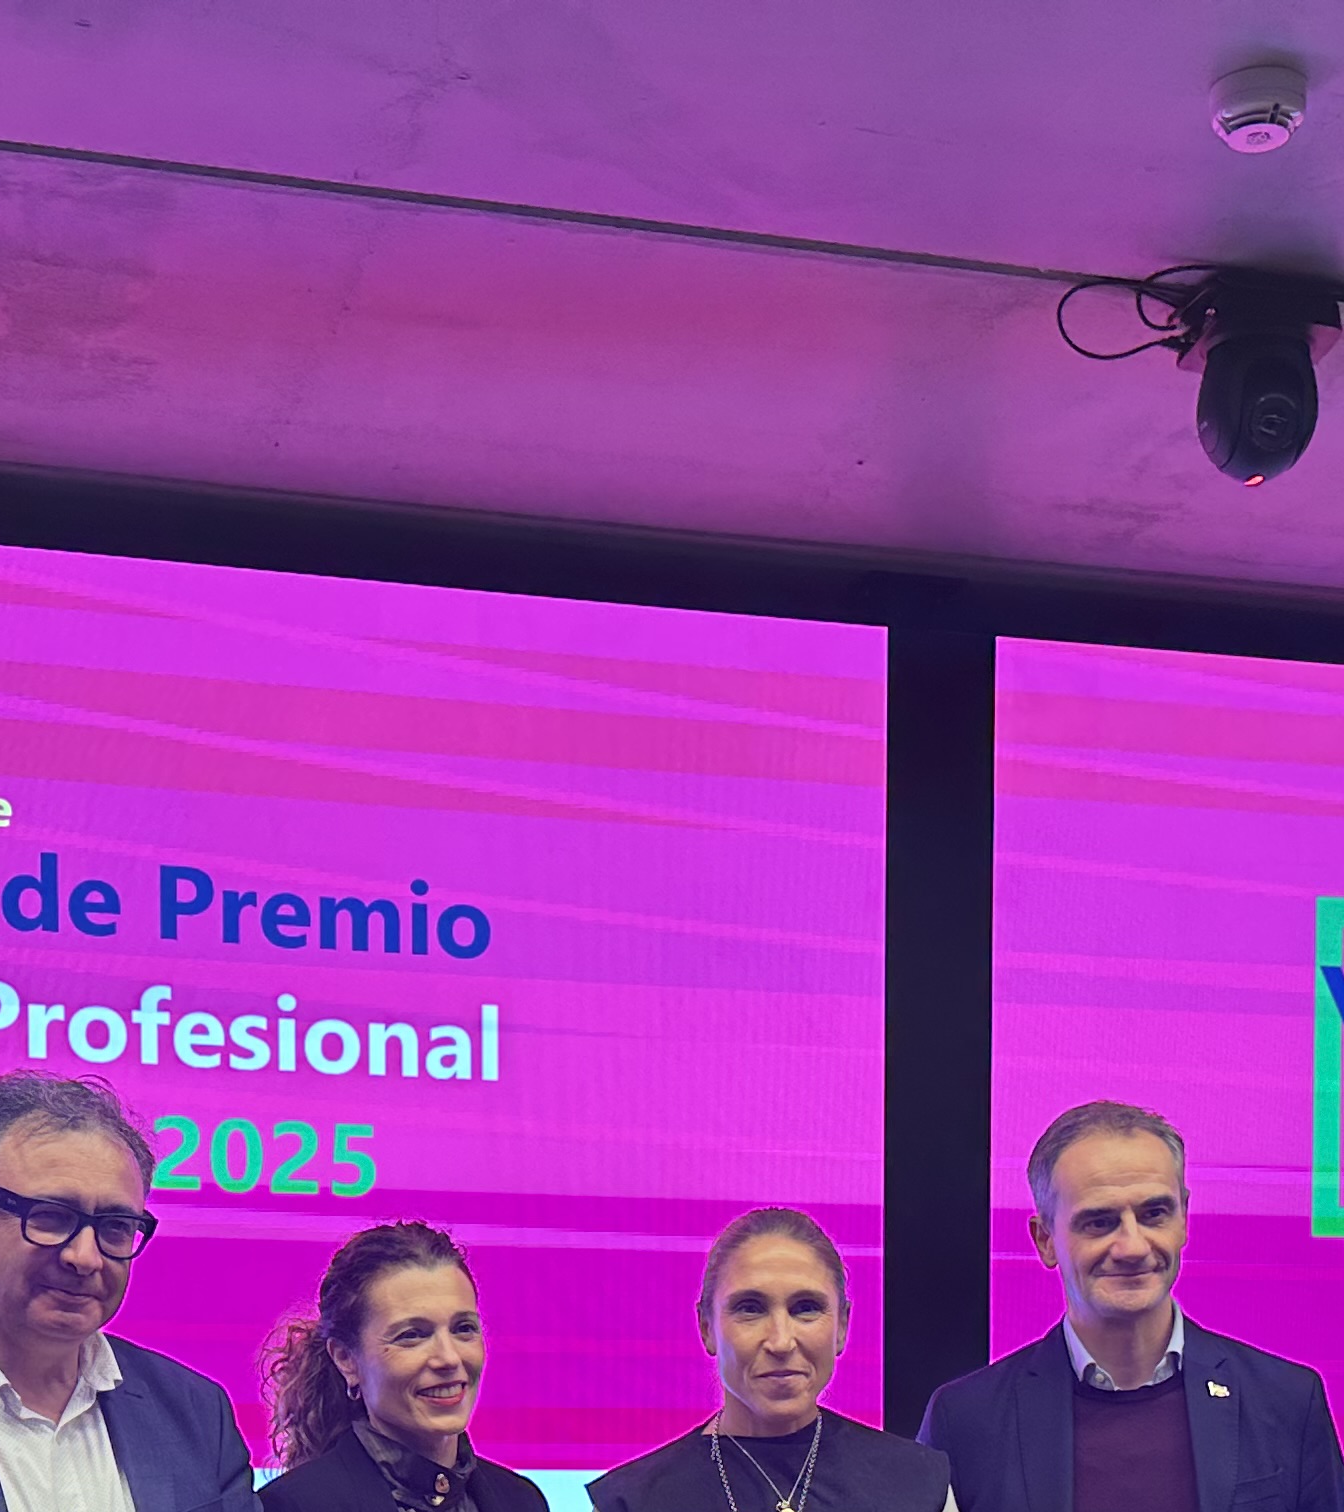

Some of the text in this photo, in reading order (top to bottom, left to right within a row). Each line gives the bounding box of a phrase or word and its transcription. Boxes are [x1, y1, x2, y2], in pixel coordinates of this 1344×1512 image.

[2, 852, 120, 938] de
[159, 864, 491, 960] Premio
[152, 1115, 378, 1198] 2025
